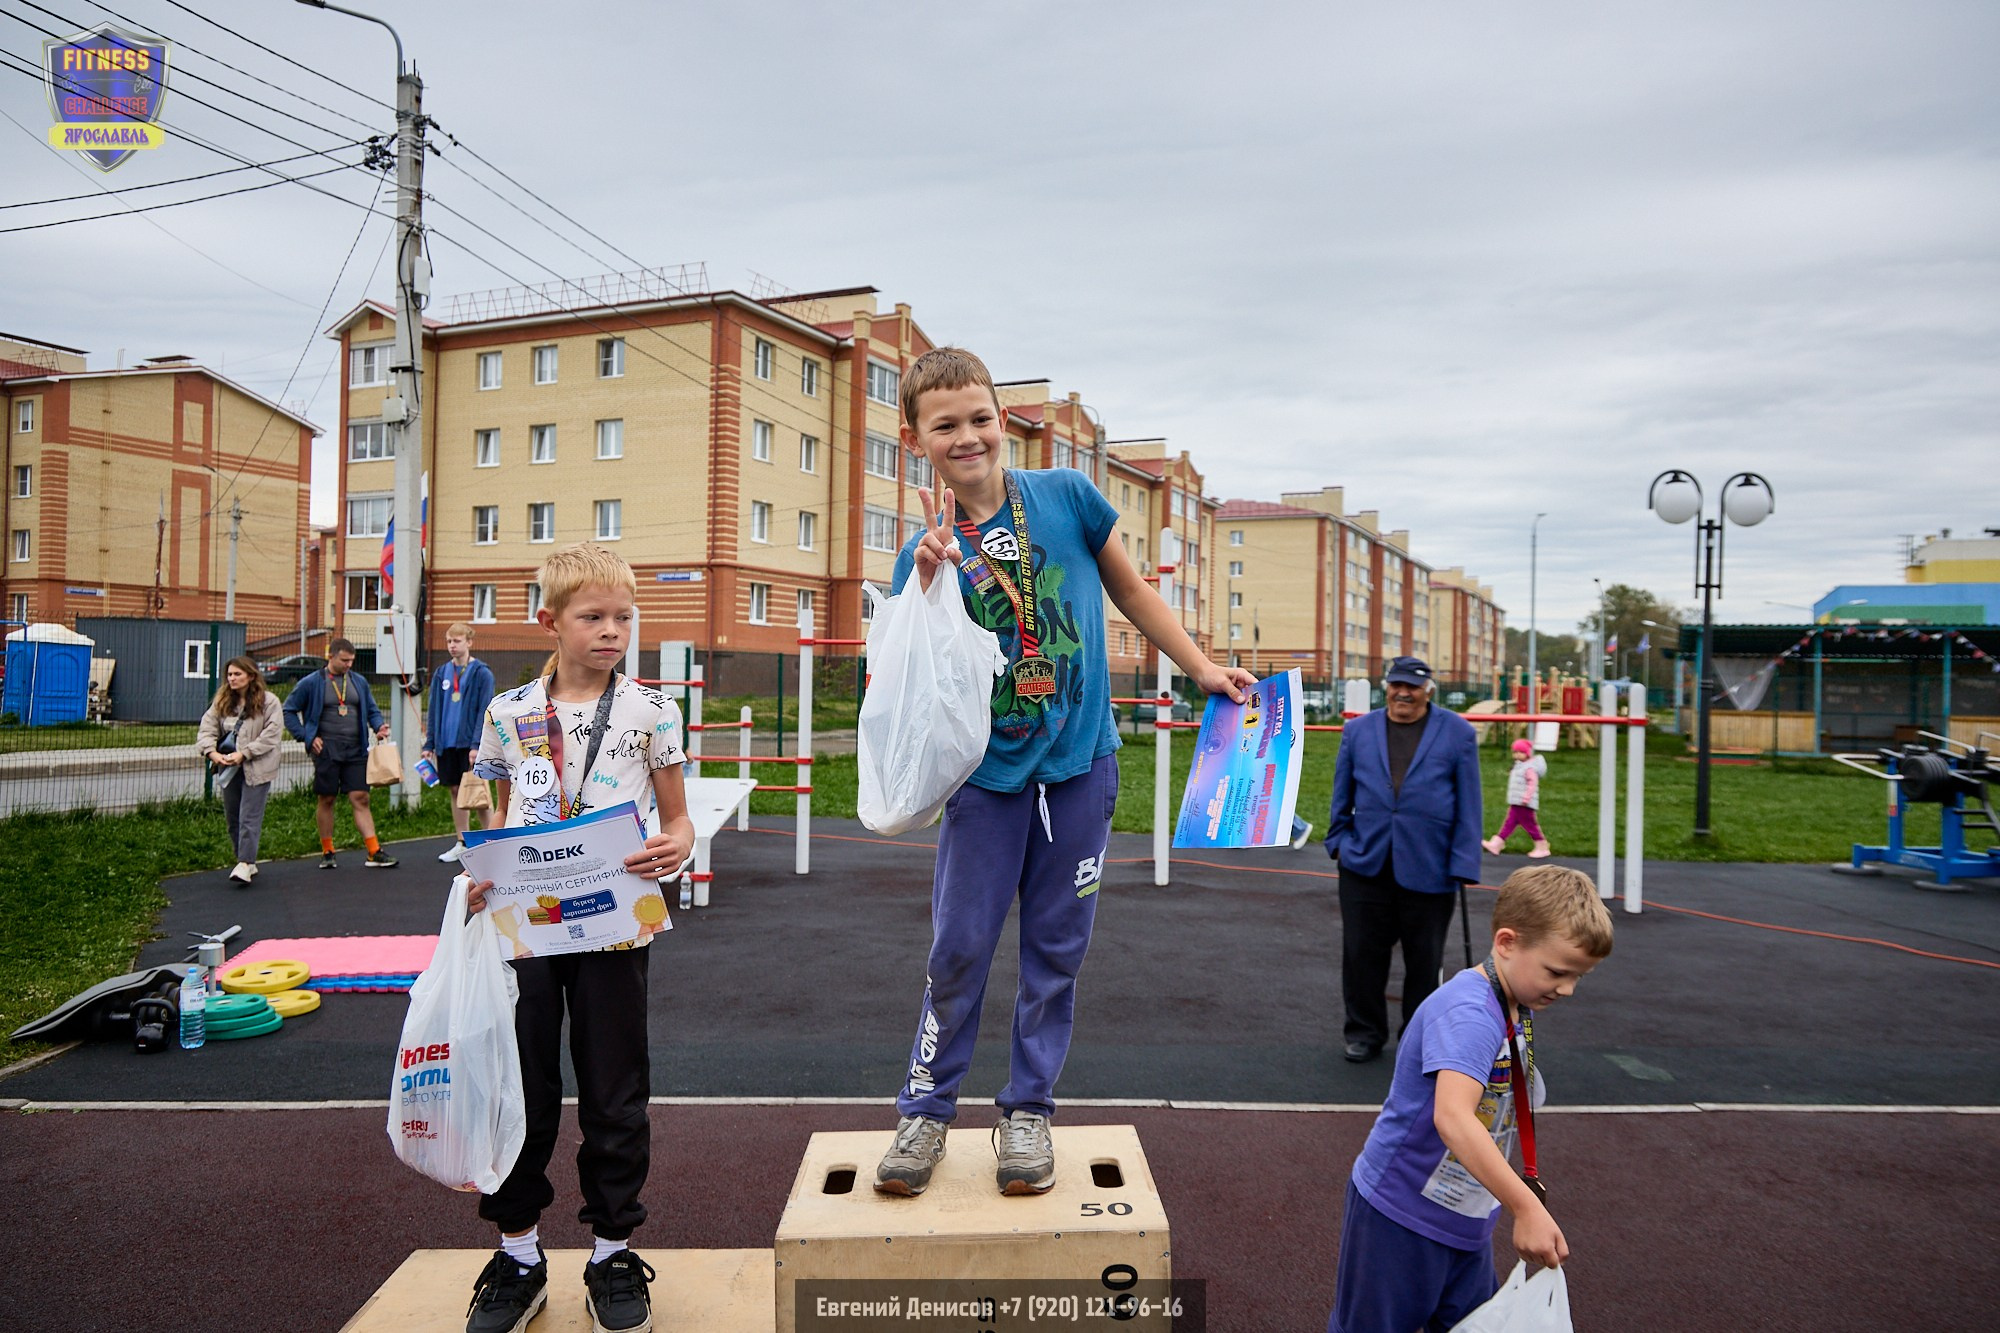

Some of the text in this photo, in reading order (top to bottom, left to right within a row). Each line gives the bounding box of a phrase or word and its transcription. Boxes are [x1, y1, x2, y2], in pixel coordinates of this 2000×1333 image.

[1012, 503, 1022, 511] 17
[1016, 530, 1035, 631] БИТВА НА СТРЕЛКЕ
[1018, 682, 1055, 693] CHALLENGE
[517, 714, 547, 725] FITNESS
[525, 770, 548, 785] 163
[492, 881, 563, 896] ПОДАРОЧНЫЙ
[565, 866, 628, 890] СЕРТИФИК
[573, 898, 596, 908] бургер
[597, 902, 612, 911] фри
[1080, 1202, 1133, 1217] 50
